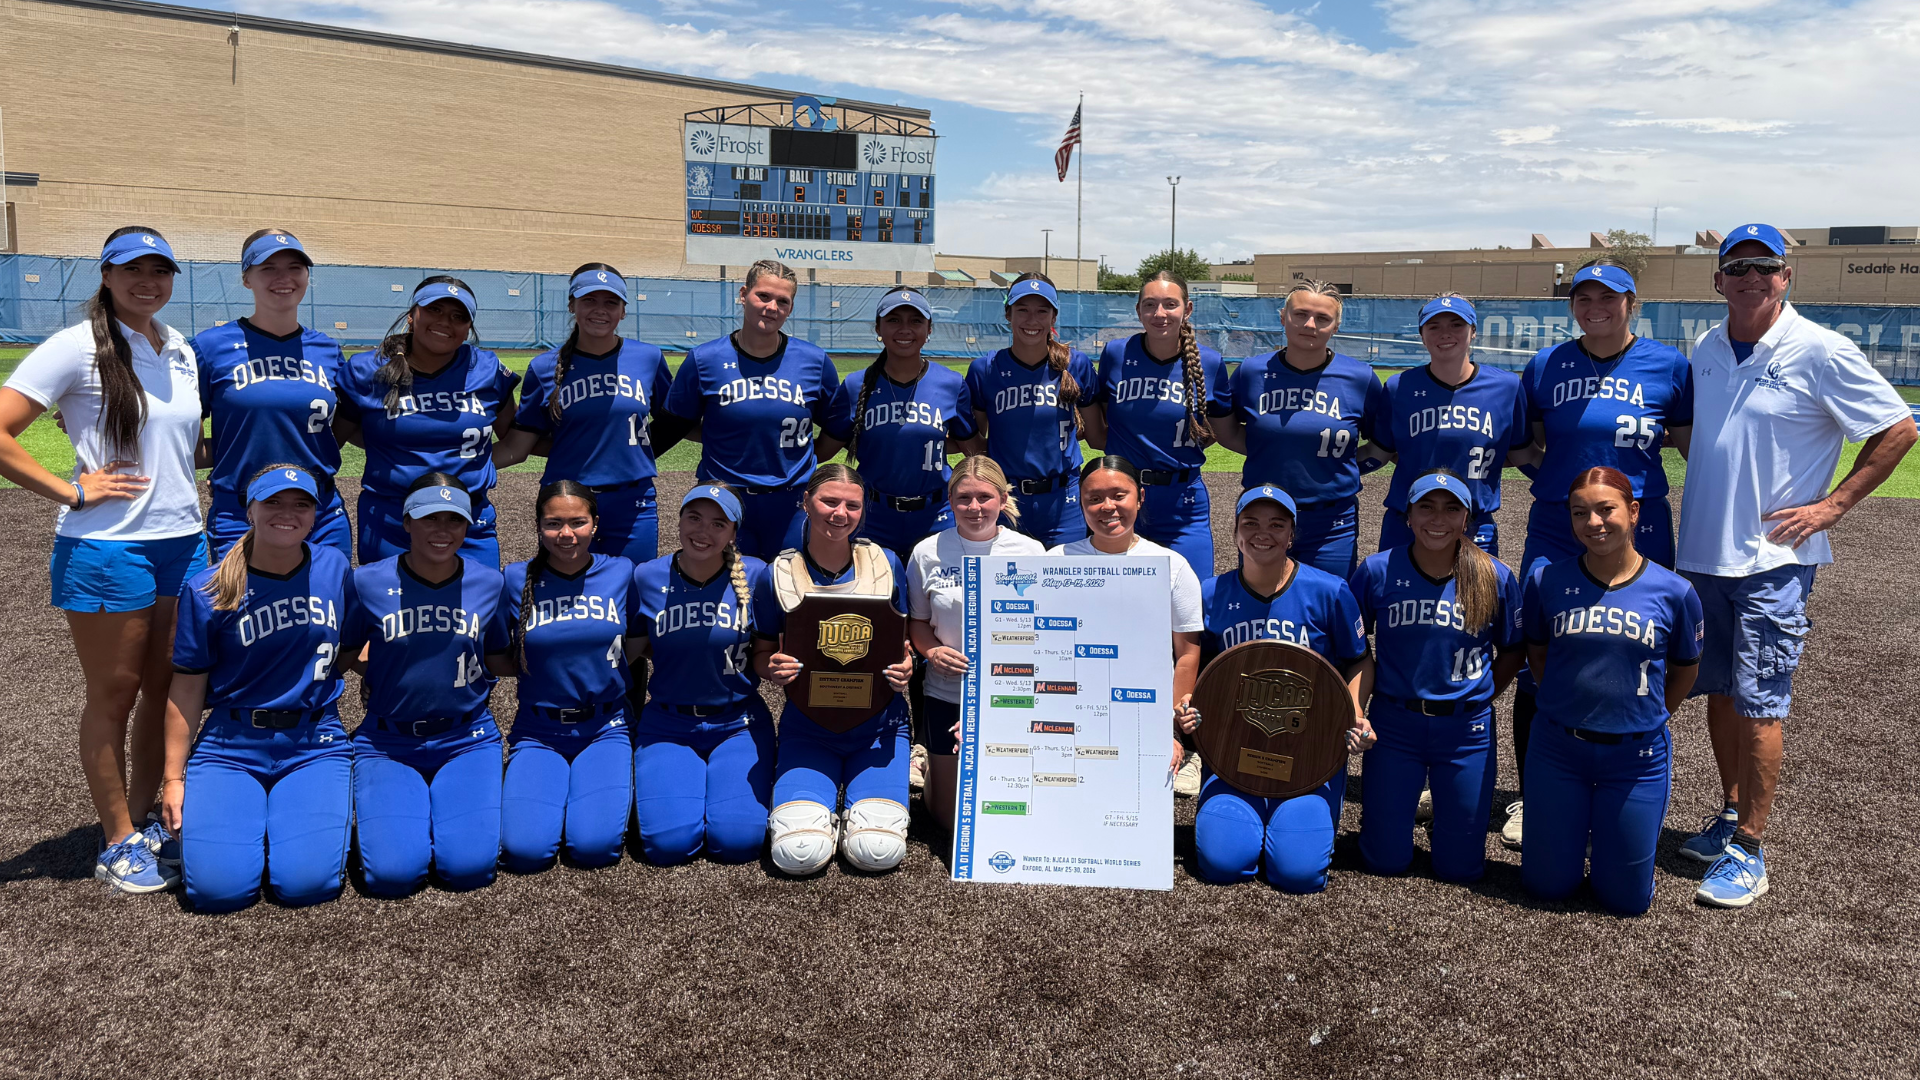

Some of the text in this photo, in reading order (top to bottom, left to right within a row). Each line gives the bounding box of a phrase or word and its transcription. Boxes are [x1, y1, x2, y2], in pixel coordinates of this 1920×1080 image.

[718, 135, 764, 155] Frost
[890, 146, 933, 165] Frost
[736, 167, 763, 181] AT BAT
[789, 170, 810, 183] BALL
[826, 172, 857, 186] STRIKE
[870, 174, 888, 187] OUT
[902, 176, 908, 188] H
[922, 177, 927, 189] E
[795, 186, 805, 202] 2
[837, 188, 846, 204] 2
[874, 190, 884, 206] 2
[691, 210, 703, 219] WC
[691, 223, 722, 233] ODESSA
[851, 230, 862, 240] 14
[774, 247, 853, 261] WRANGLERS
[1292, 272, 1304, 280] W2
[1847, 262, 1920, 274] Sedate Ha
[233, 356, 332, 392] ODESSA
[560, 373, 647, 410] ODESSA
[718, 376, 806, 409] ODESSA
[1259, 387, 1342, 420] ODESSA
[1553, 376, 1645, 409] ODESSA
[628, 413, 650, 446] 14
[864, 401, 944, 432] ODESSA
[1409, 405, 1494, 439] ODESSA
[460, 425, 493, 459] 27
[1059, 420, 1071, 452] 5
[1317, 427, 1350, 458] 19
[1614, 414, 1656, 450] 25
[922, 440, 944, 471] 13
[1467, 446, 1496, 479] 22
[1042, 567, 1157, 576] WRANGLER SOFTBALL COMPLEX
[1042, 578, 1063, 589] May
[1084, 579, 1105, 587] 2026
[968, 590, 977, 616] REGION
[239, 596, 337, 647] ODESSA
[382, 605, 479, 643] ODESSA
[1048, 619, 1073, 627] ODESSA
[1388, 599, 1478, 639] ODESS
[1553, 606, 1655, 650] ODESSA
[820, 622, 871, 646] NJCAA
[968, 628, 977, 653] NJCAA
[1002, 634, 1035, 642] WEATHERFORD
[1222, 618, 1311, 650] ODESSA
[606, 634, 622, 669] 4
[723, 641, 750, 675] 15
[1089, 646, 1114, 655] ODESSA
[1451, 647, 1483, 682] 10
[1636, 659, 1650, 696] 1
[967, 660, 977, 697] SOFTBALL
[1126, 690, 1152, 699] ODESSA
[1240, 678, 1310, 708] NJCAA
[966, 706, 976, 732] REGION
[1291, 717, 1300, 728] 5
[965, 744, 974, 771] NJCAA
[962, 777, 973, 816] SOFTBALL
[960, 825, 971, 853] REGION
